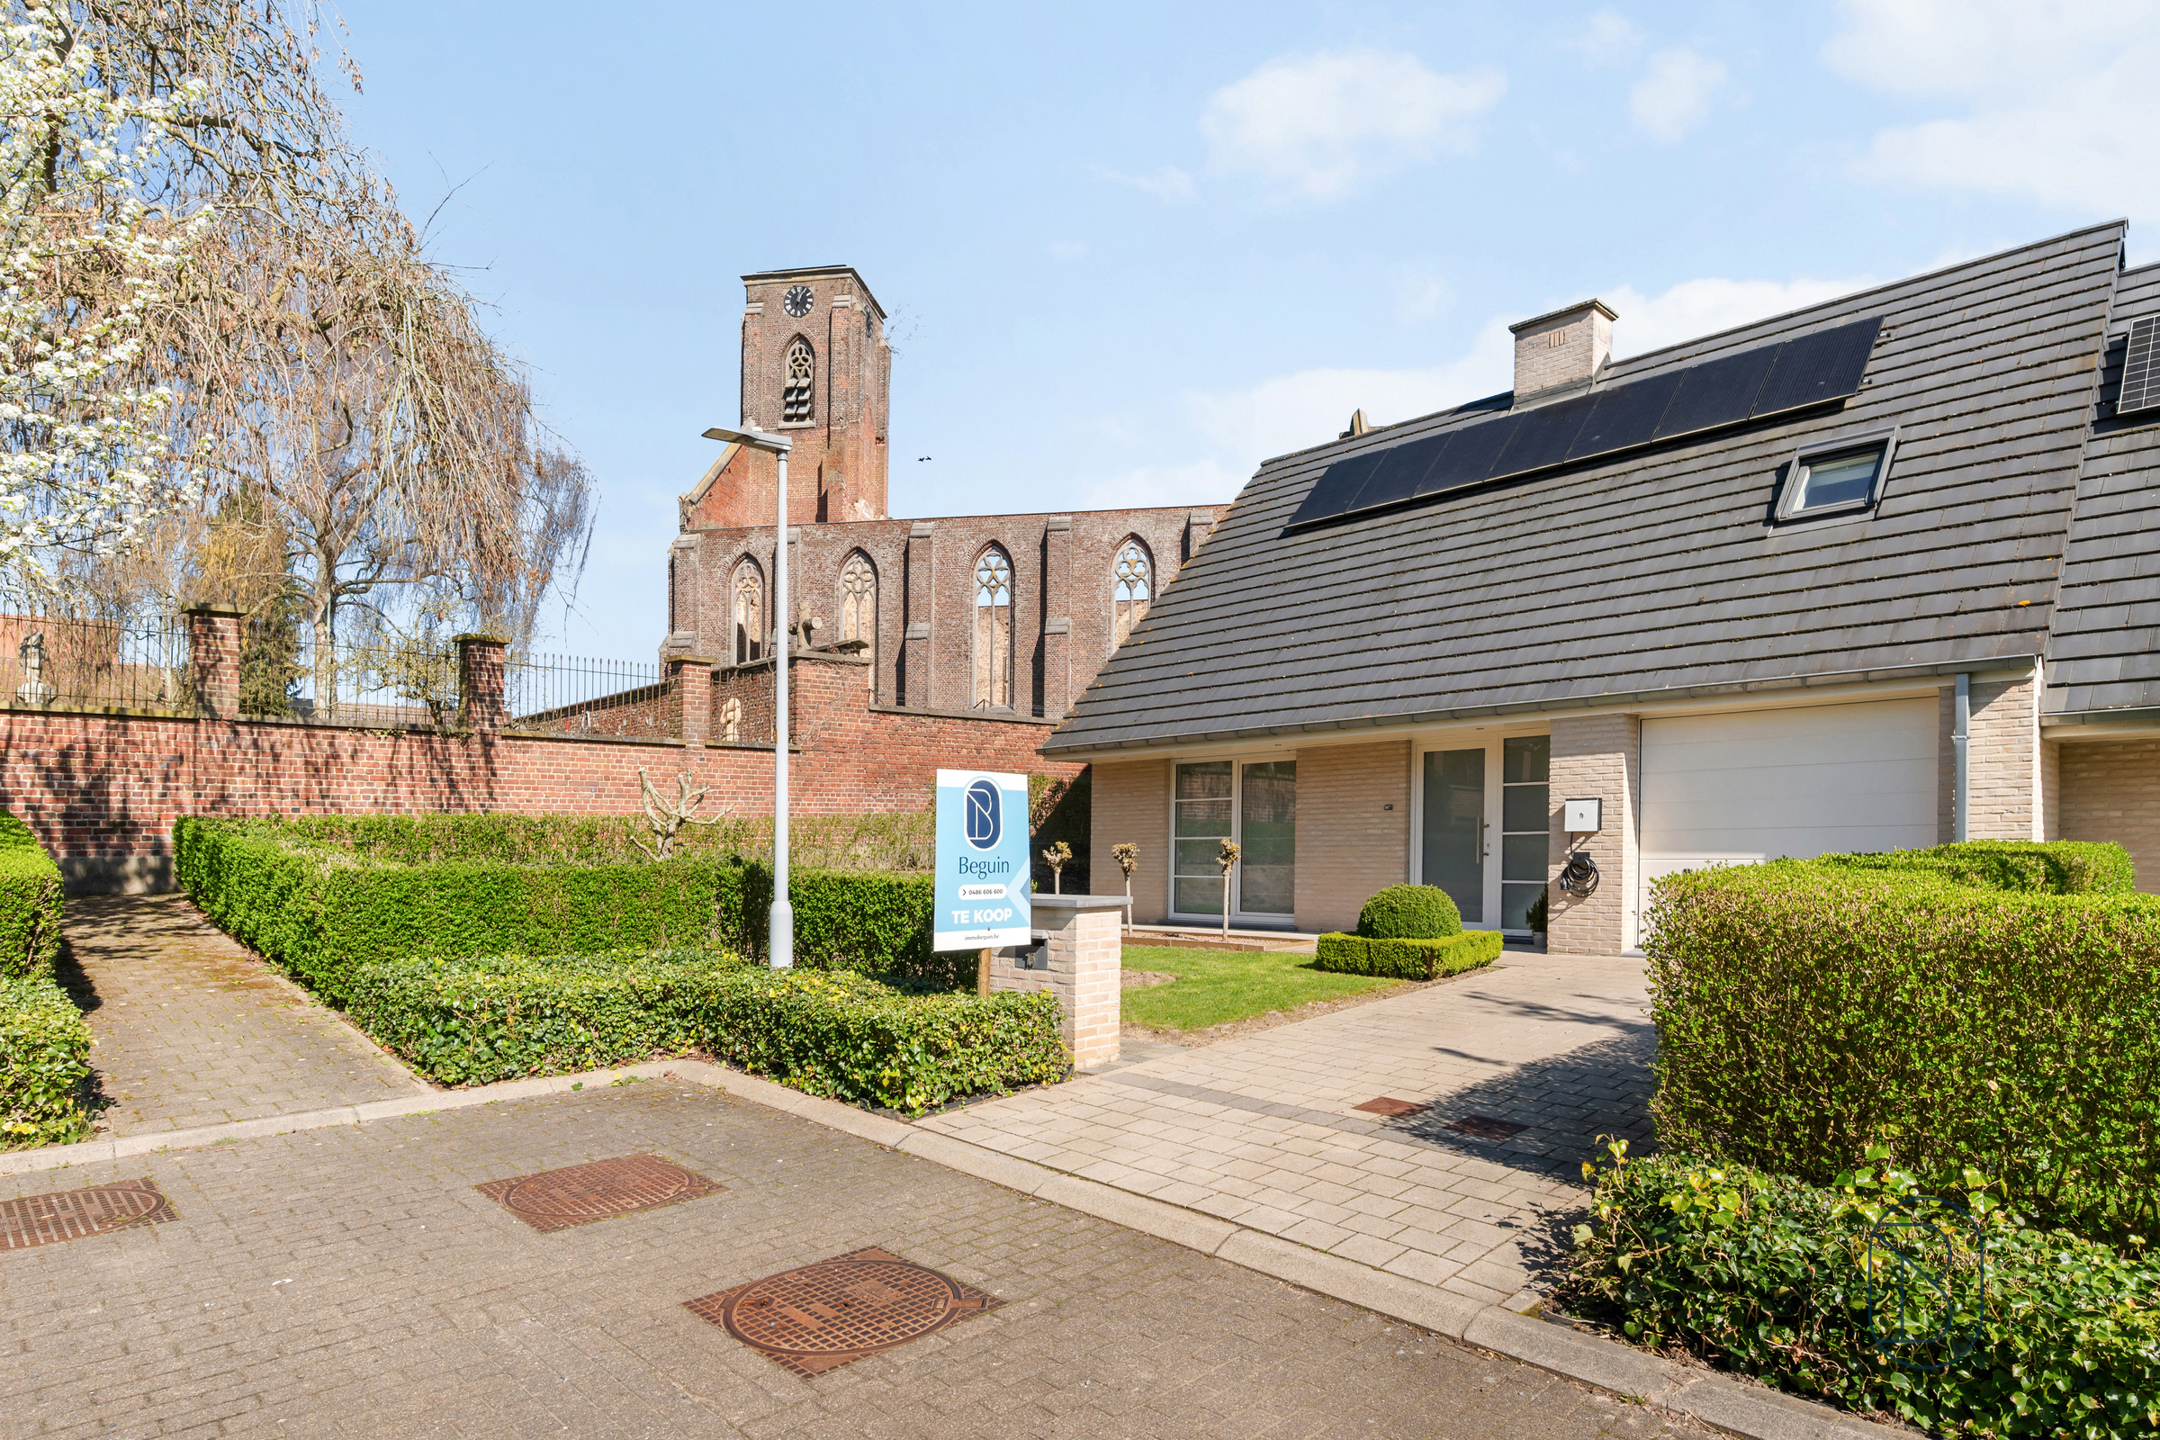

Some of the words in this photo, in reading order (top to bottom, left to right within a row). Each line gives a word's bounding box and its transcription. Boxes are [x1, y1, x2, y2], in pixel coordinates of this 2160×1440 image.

[958, 856, 1010, 880] Beguin
[951, 910, 970, 924] TE
[973, 908, 1013, 923] KOOP
